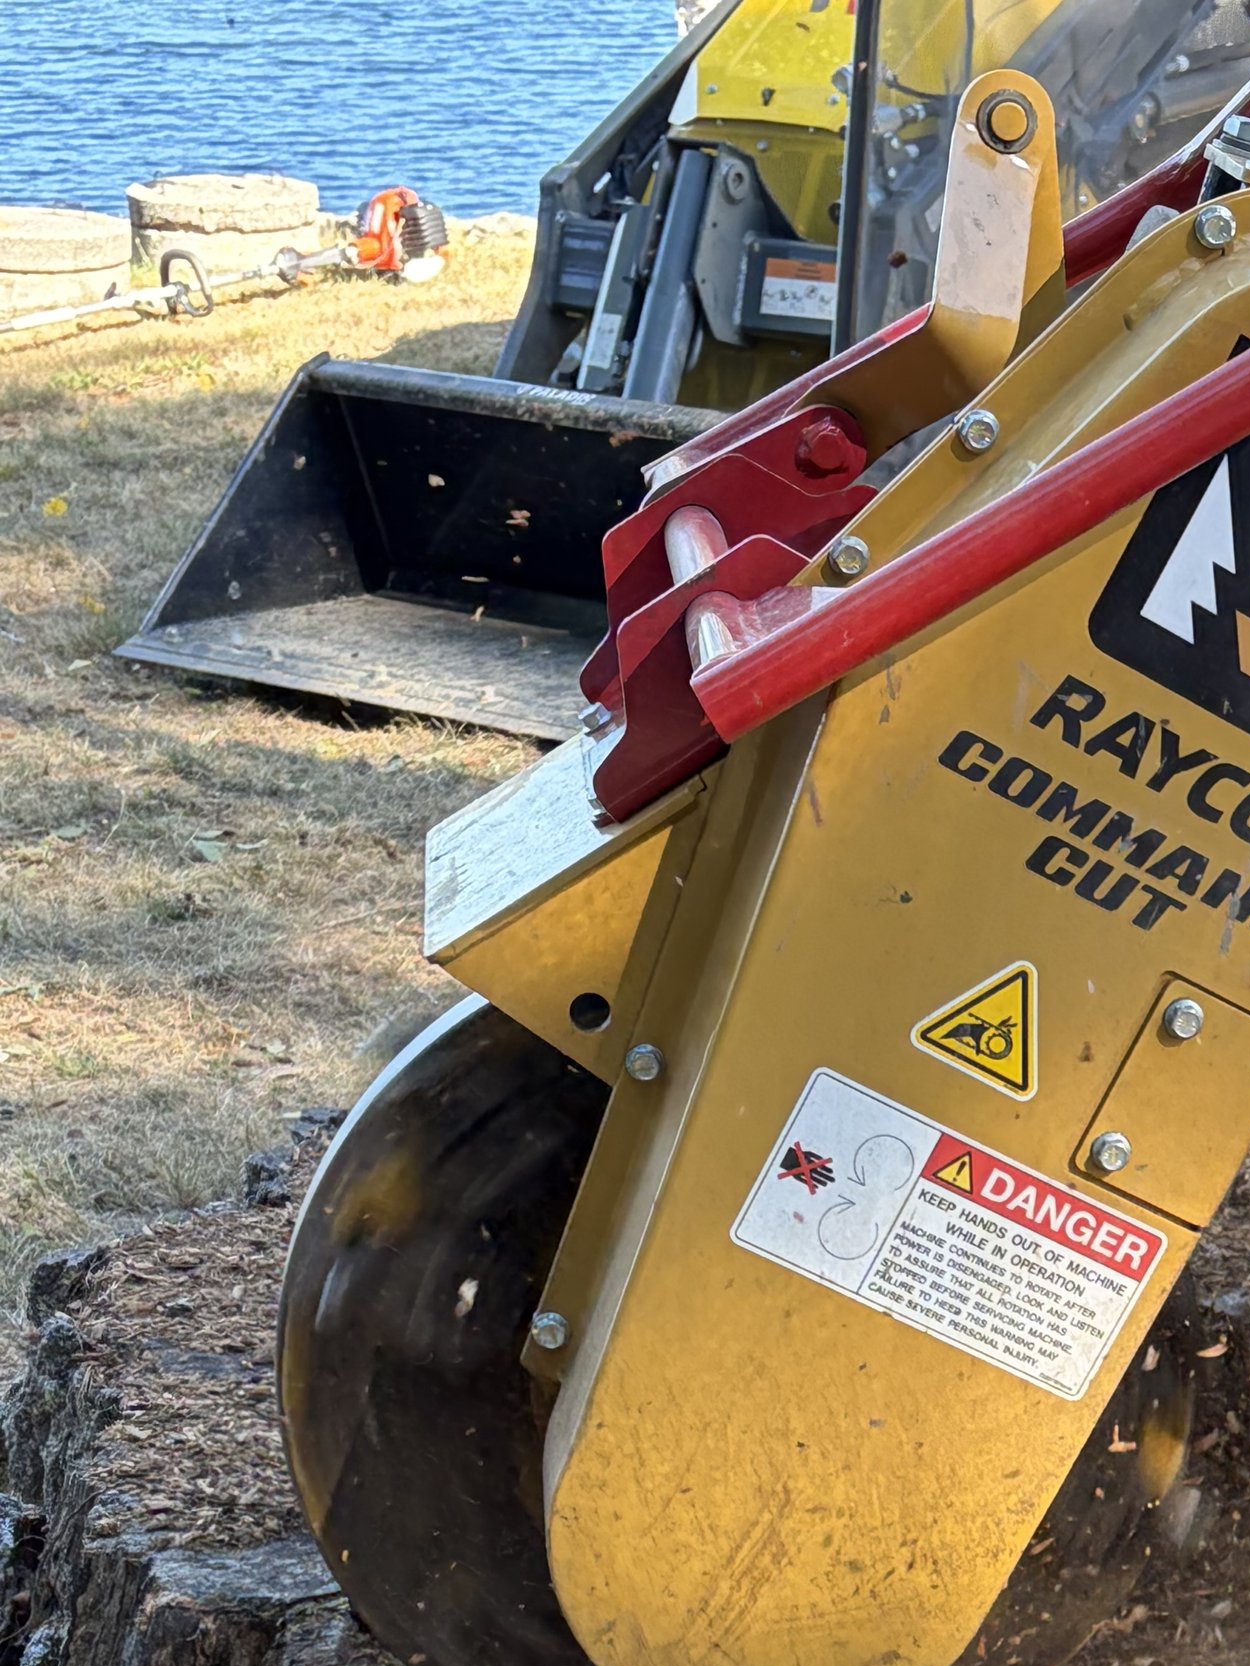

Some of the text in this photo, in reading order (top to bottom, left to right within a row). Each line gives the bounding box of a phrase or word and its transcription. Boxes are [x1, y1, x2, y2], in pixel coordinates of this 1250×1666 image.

[1024, 835, 1188, 932] CUT
[917, 1188, 1128, 1297] KEEP HANDS OUT OF MACHINE
[945, 1221, 1086, 1298] WHILE IN OPERATION
[980, 1167, 1149, 1271] DANGER
[867, 1281, 905, 1305] CAUSE
[905, 1299, 946, 1324] SEVERE
[948, 1319, 999, 1351] PERSONAL
[873, 1269, 1059, 1362] FAILURE TO HEED THIS WARNING MAY
[880, 1257, 927, 1285] STOPPED
[929, 1280, 970, 1306] BEFORE
[972, 1301, 1026, 1332] SERVICING
[888, 1245, 1068, 1337] TO ASSURE THAT ALL ROTATION HAS
[893, 1233, 932, 1257] POWER
[933, 1251, 945, 1263] IS
[1016, 1292, 1045, 1311] LOOK
[1047, 1307, 1068, 1322] AND
[1070, 1317, 1105, 1340] LISTEN
[900, 1221, 1096, 1321] MACHINE CONTINUES TO ROTATE AFTER
